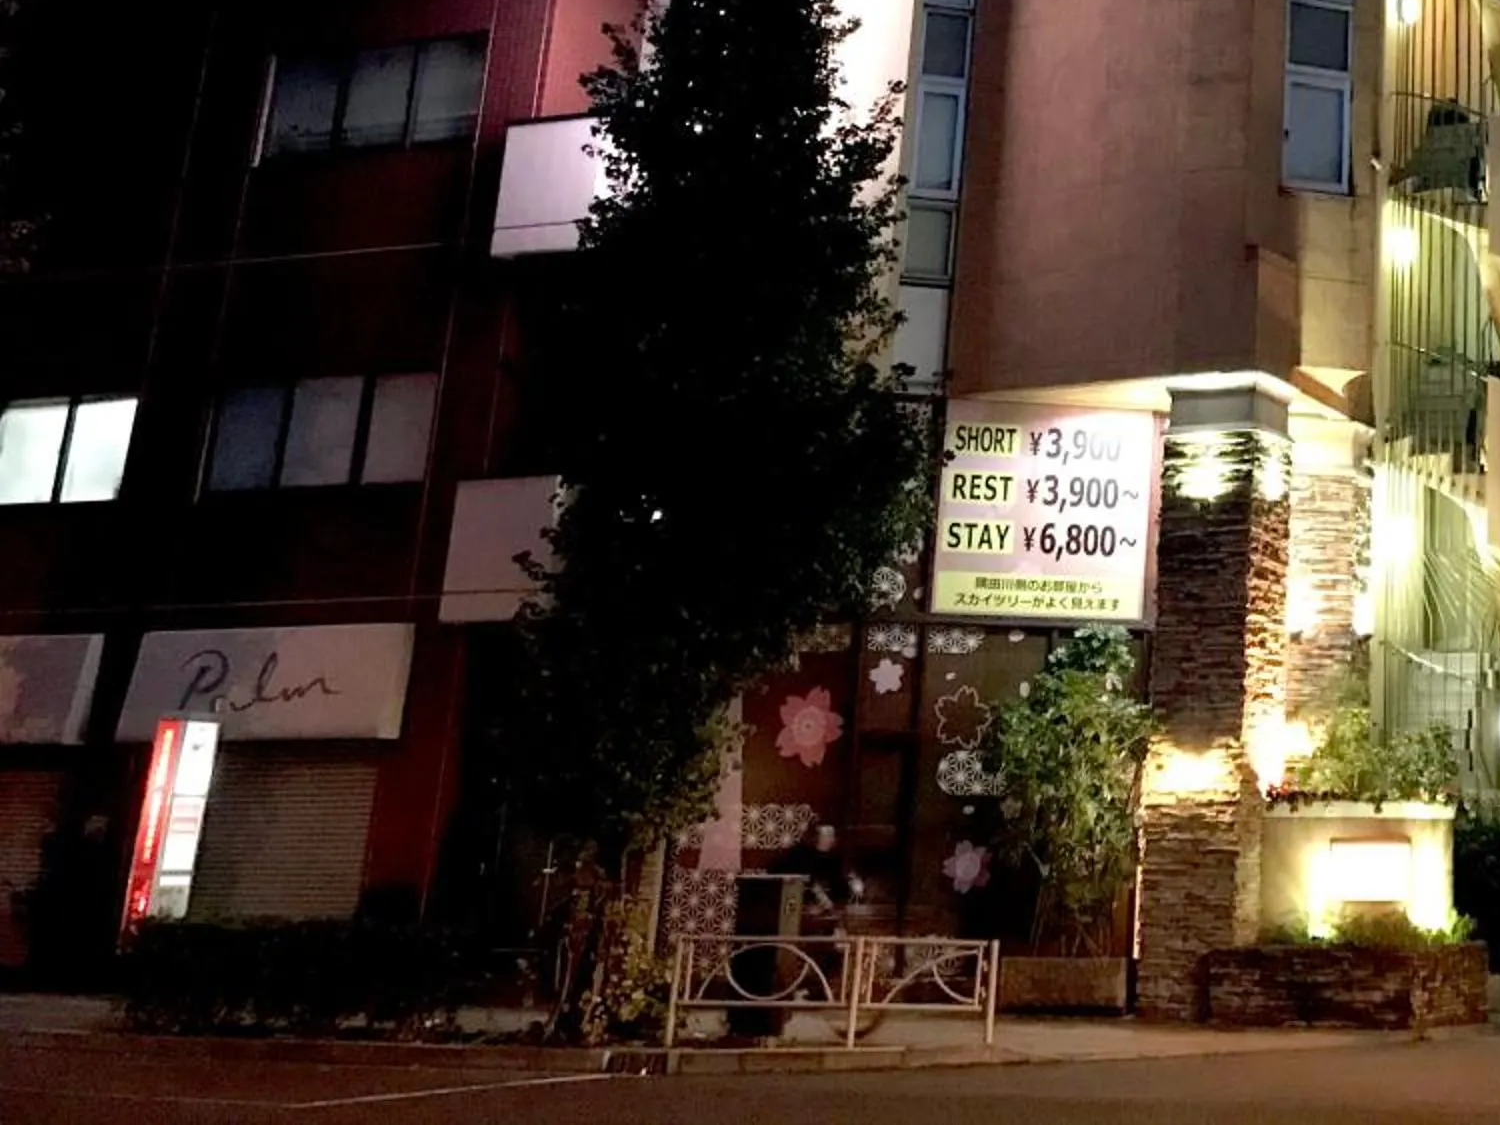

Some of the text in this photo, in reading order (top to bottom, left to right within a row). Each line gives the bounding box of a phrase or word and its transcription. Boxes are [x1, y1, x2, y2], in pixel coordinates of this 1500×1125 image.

[955, 425, 1017, 454] SHORT
[951, 473, 1013, 502] REST
[947, 522, 1010, 550] STAY
[953, 592, 1120, 611] スカイツリーがよく見えます
